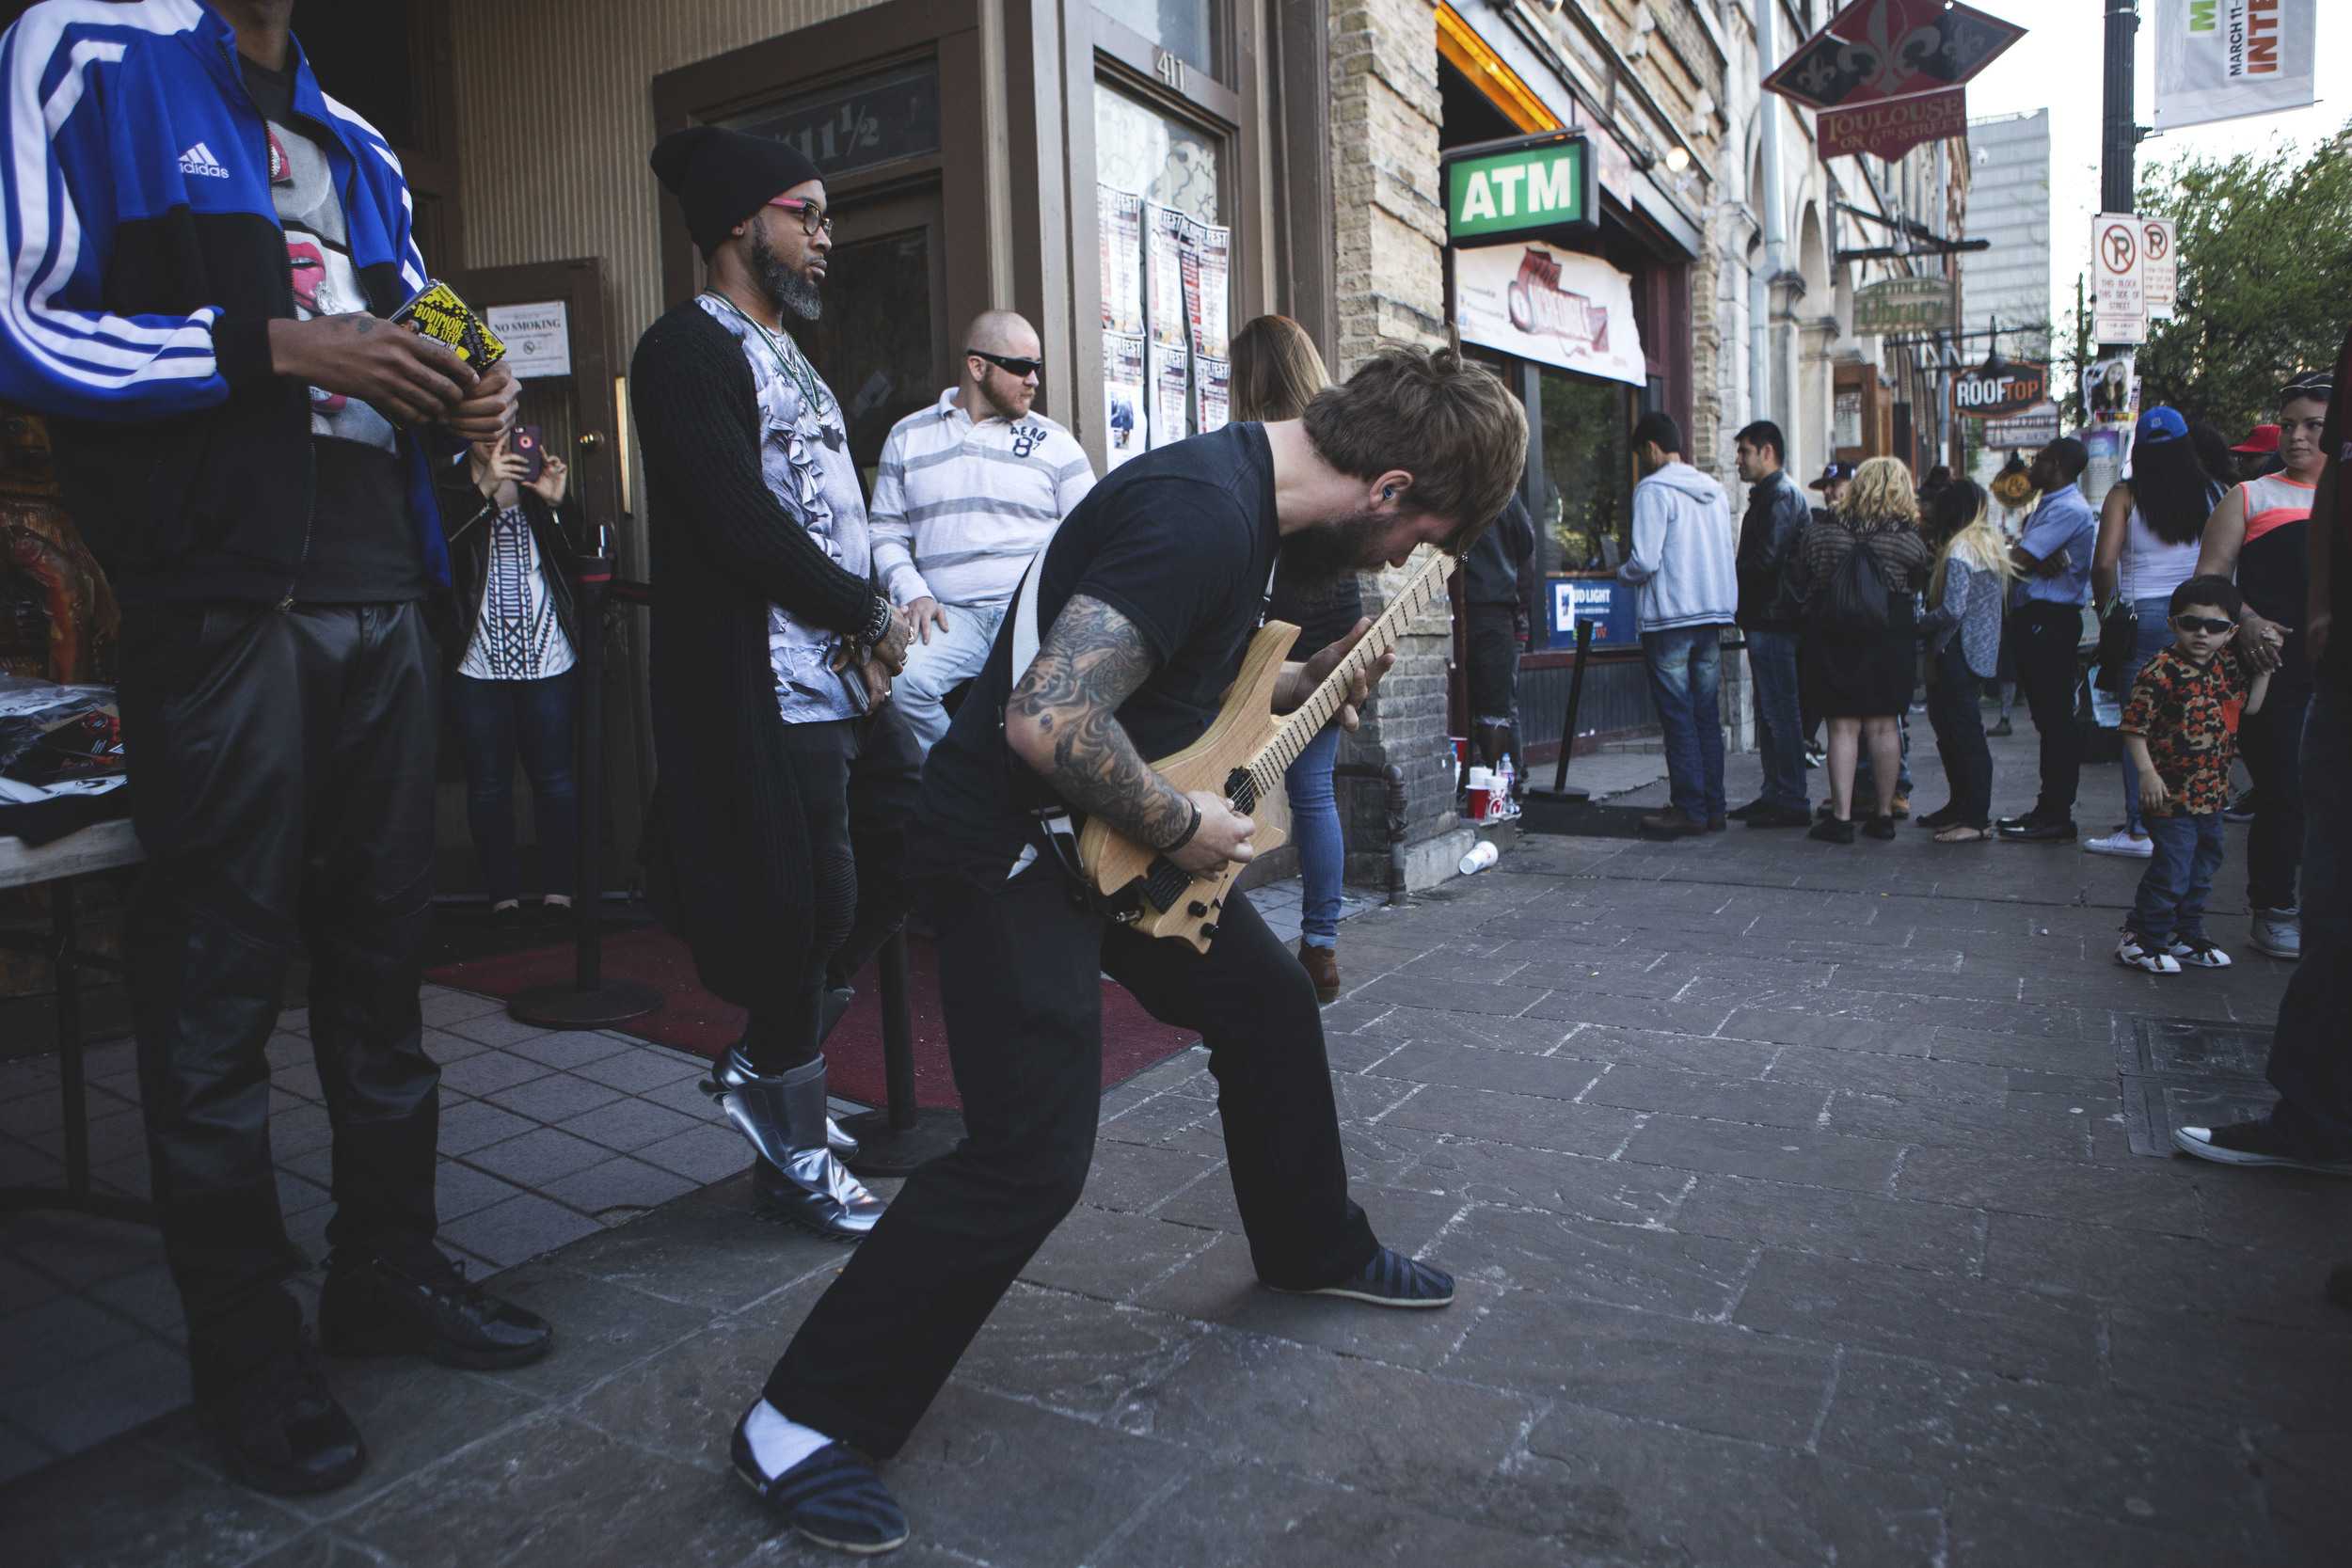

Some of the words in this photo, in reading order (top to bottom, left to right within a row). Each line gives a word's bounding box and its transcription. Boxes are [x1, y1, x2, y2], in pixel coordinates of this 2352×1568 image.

[2230, 23, 2242, 76] MARCH
[1157, 51, 1184, 92] 411
[1820, 97, 1960, 142] TOULOUSE
[1898, 118, 1961, 141] STREET
[1460, 157, 1571, 222] ATM
[414, 303, 468, 334] BODYMORE
[494, 324, 509, 332] NO
[511, 319, 561, 332] SMOKING
[425, 323, 439, 337] BIG
[438, 328, 464, 345] STEVE
[1009, 426, 1047, 441] AERO
[1586, 588, 1612, 603] LIGHT
